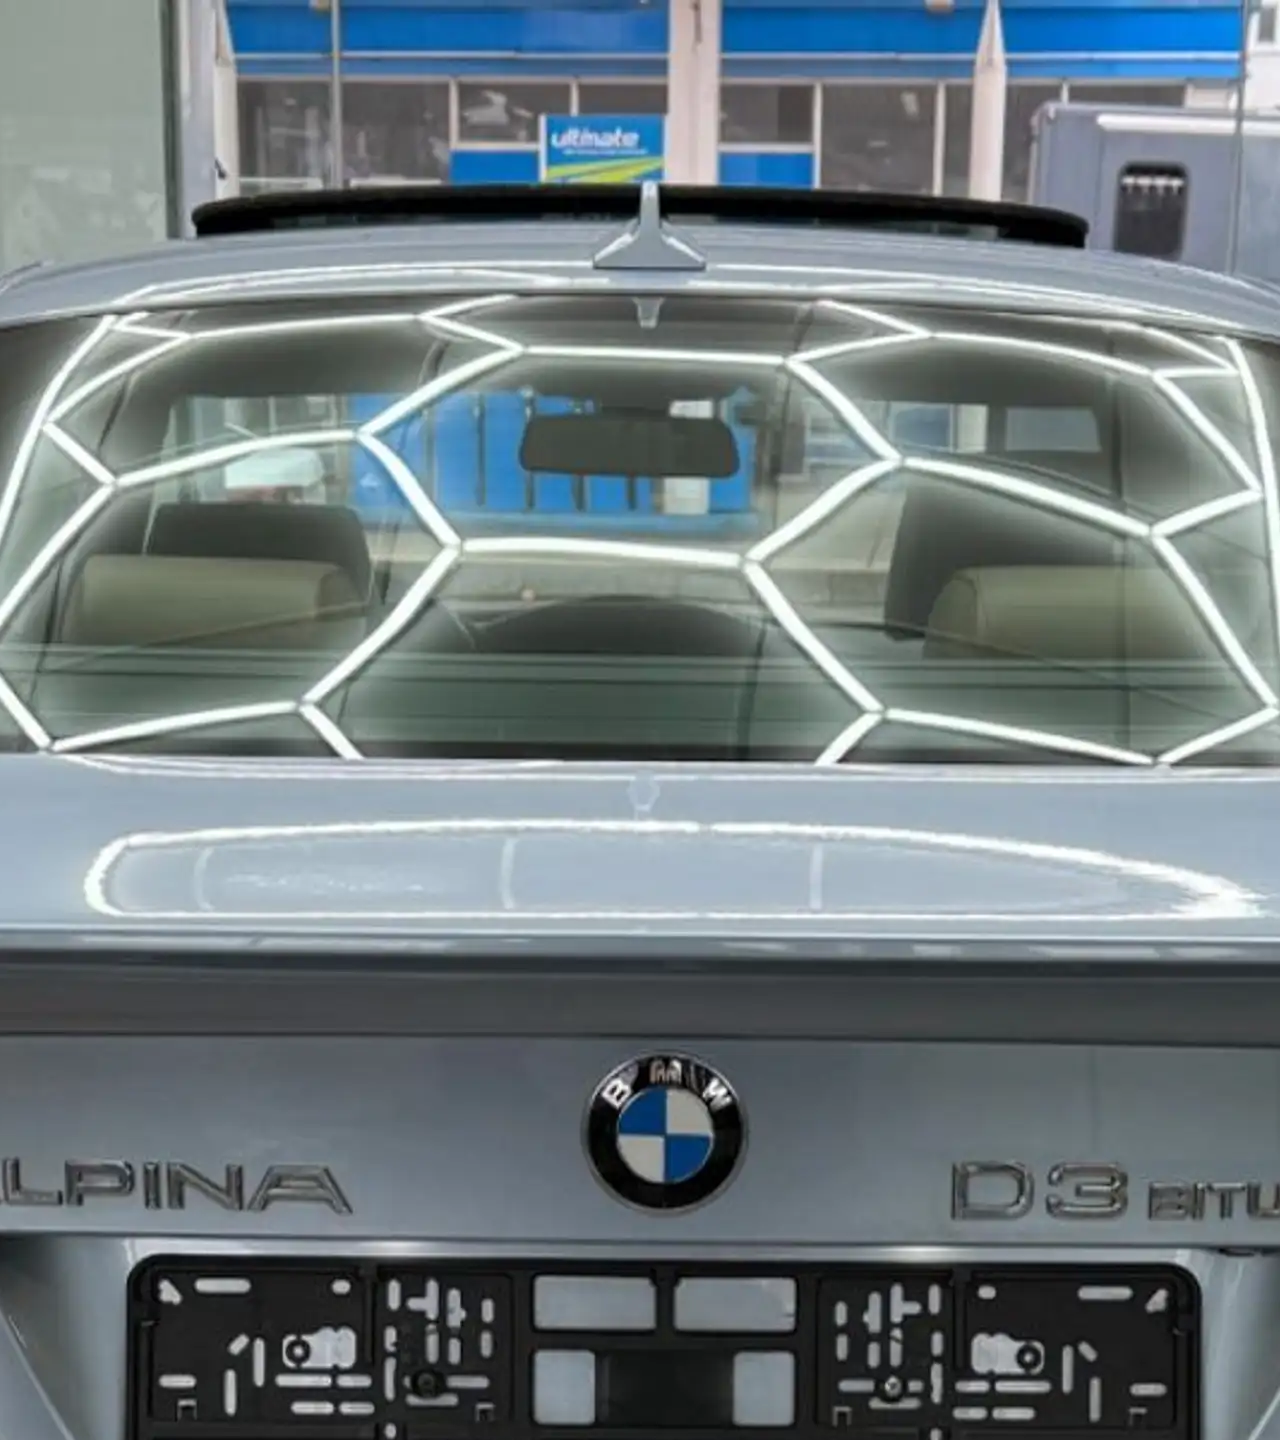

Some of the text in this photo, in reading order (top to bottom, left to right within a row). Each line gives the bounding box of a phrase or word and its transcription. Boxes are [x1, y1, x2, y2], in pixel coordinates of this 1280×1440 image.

[550, 127, 640, 149] ultimate
[600, 1059, 733, 1112] BMW
[950, 1160, 1129, 1221] D3
